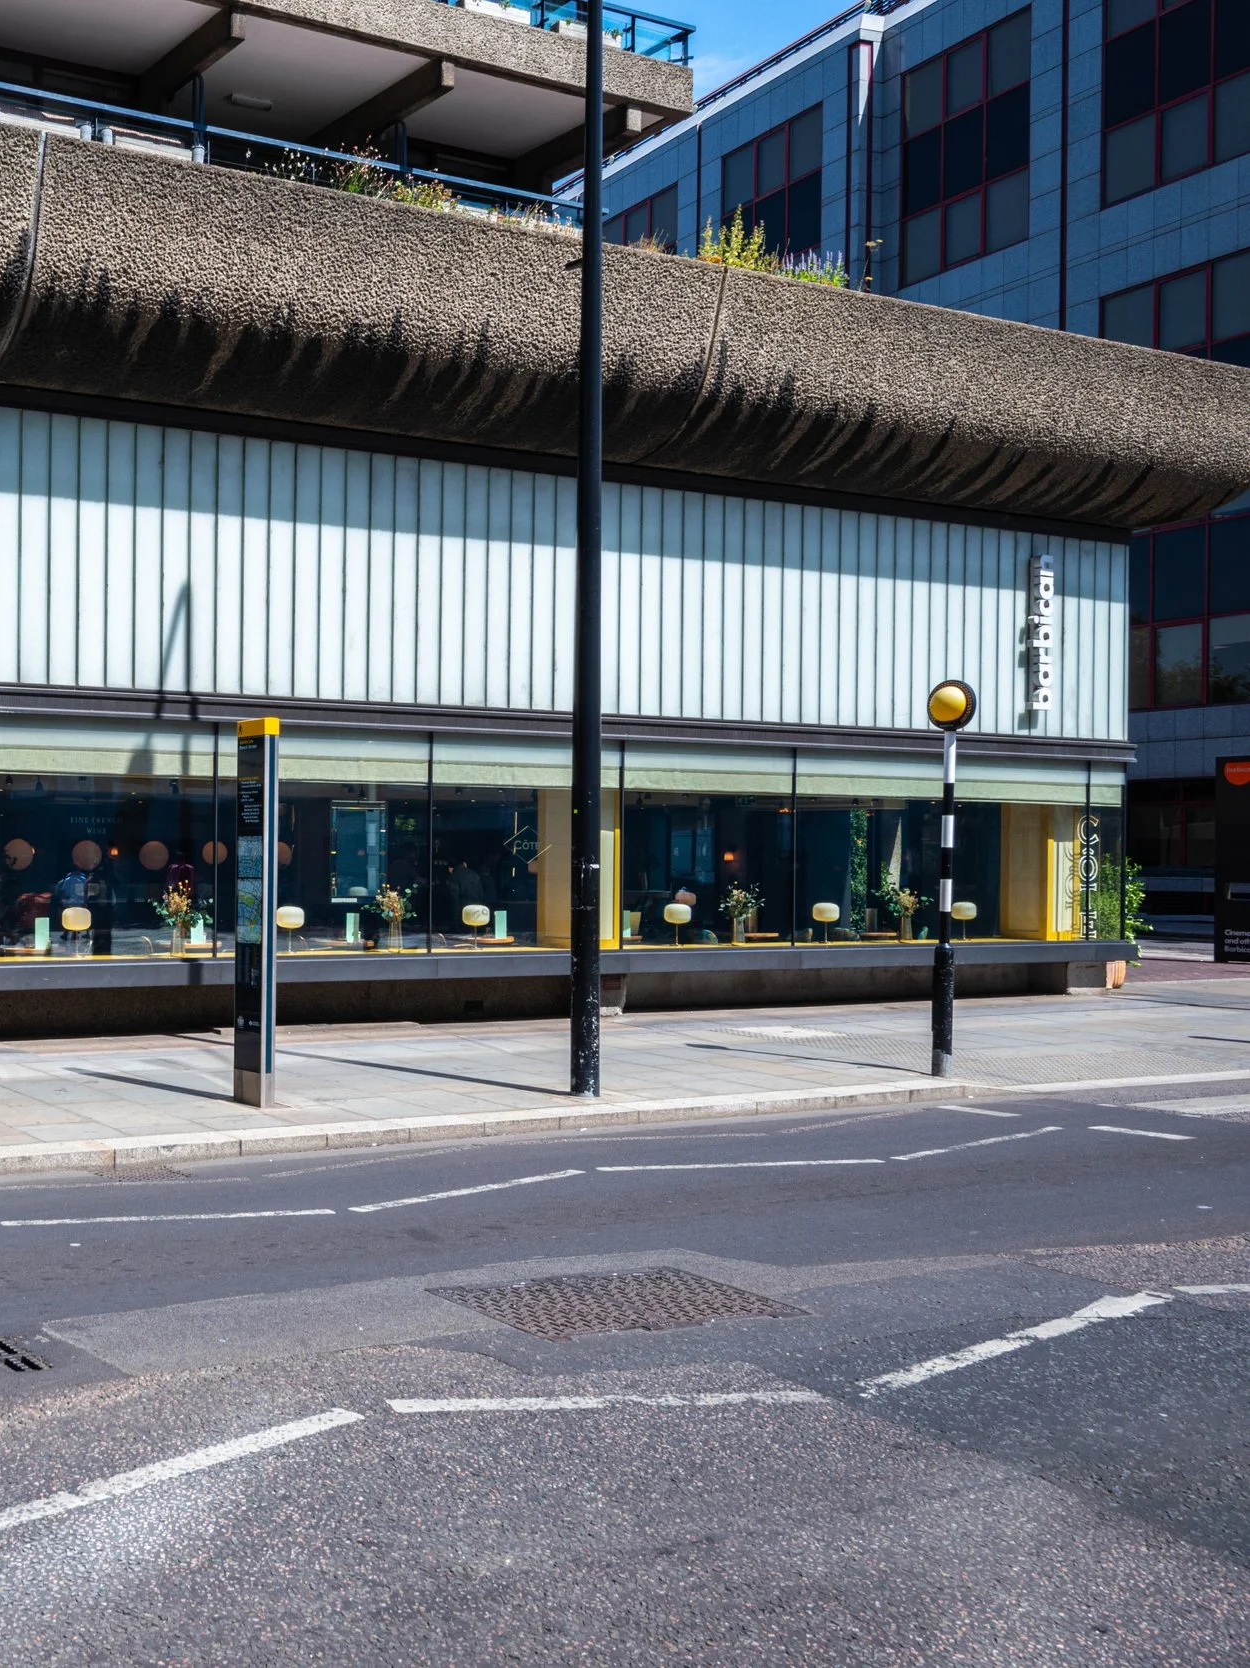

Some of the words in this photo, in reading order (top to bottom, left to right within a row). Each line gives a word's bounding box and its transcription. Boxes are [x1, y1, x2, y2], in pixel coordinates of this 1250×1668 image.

[1028, 555, 1054, 711] barbican
[1076, 814, 1100, 940] CÔTE
[1224, 937, 1239, 945] and
